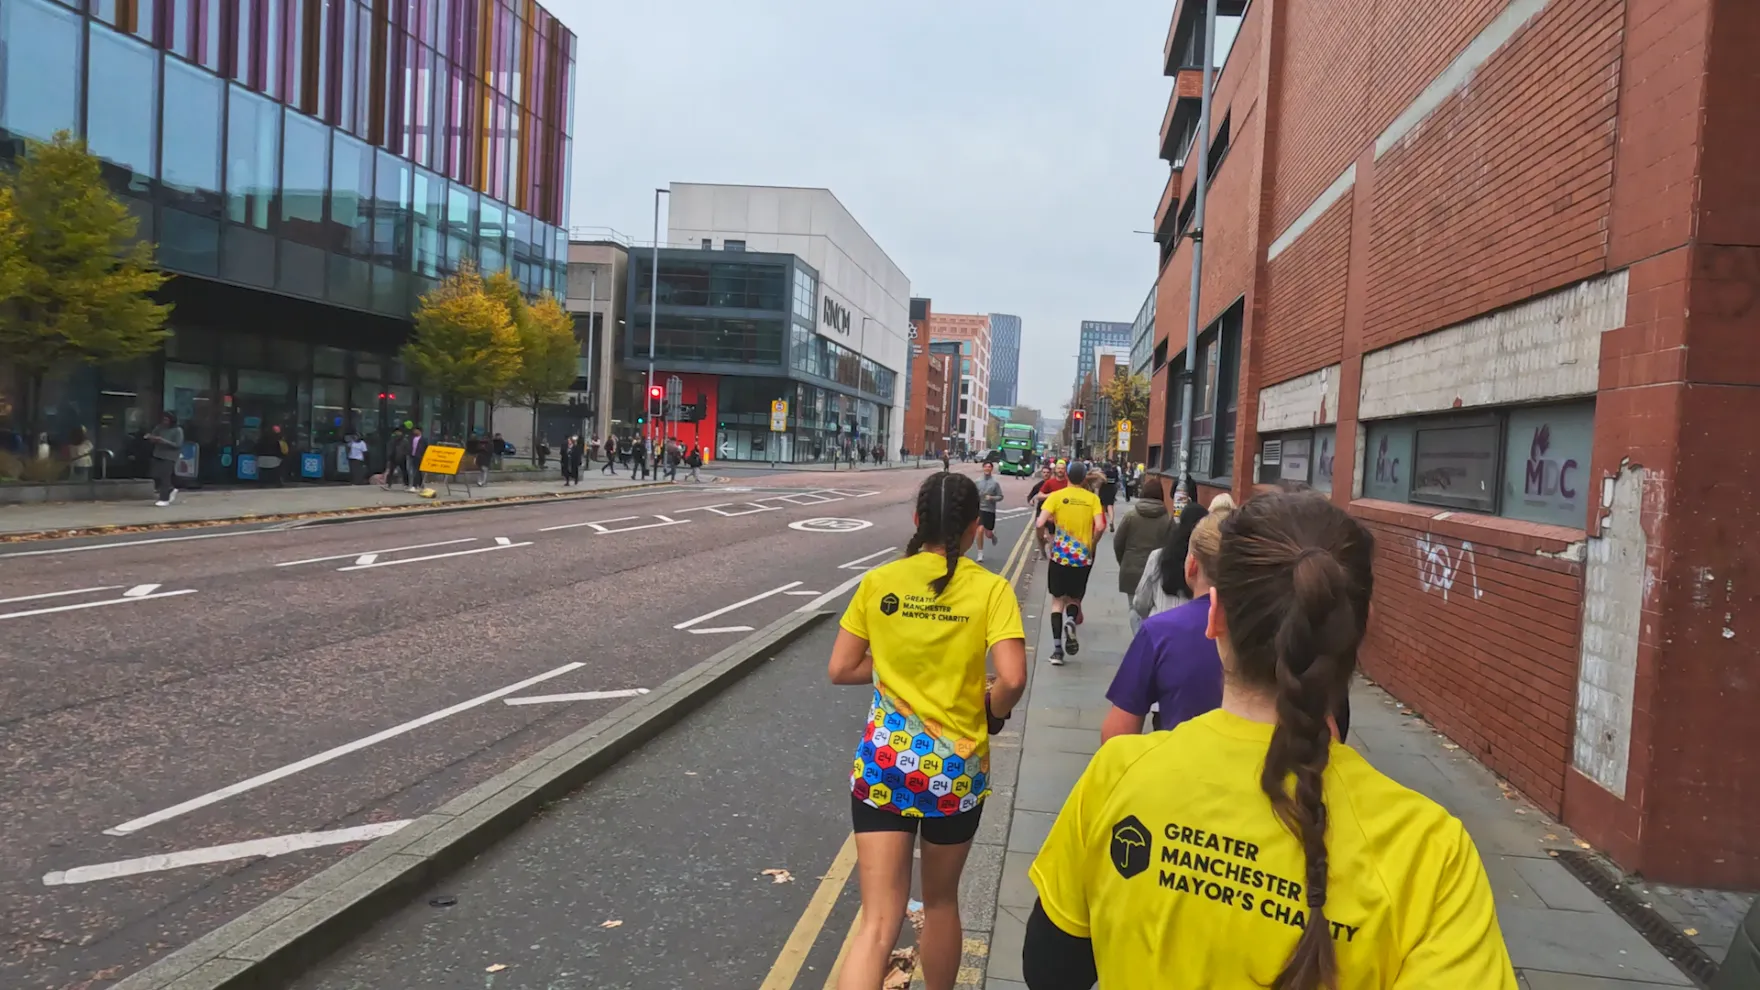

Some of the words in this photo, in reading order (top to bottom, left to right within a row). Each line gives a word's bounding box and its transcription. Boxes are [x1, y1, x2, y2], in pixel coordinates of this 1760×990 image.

[823, 295, 850, 337] RNCM
[1525, 459, 1578, 499] MDC
[902, 602, 952, 613] MANCHESTER
[901, 611, 936, 620] MAYOR'S
[938, 614, 970, 623] CHARITY
[874, 731, 888, 740] 24
[893, 735, 908, 746] 24
[915, 739, 930, 750] 24
[878, 752, 892, 763] 24
[900, 755, 915, 767] 24
[923, 759, 938, 770] 24
[947, 762, 960, 772] 24
[866, 768, 879, 779] 24
[909, 777, 924, 787] 24
[933, 780, 948, 791] 24
[956, 781, 969, 791] 24
[872, 789, 887, 800] 24
[895, 793, 910, 804] 24
[1164, 823, 1259, 861] GREATER
[1161, 846, 1302, 902] MANCHESTER
[1159, 870, 1255, 911] MAYOR'S
[1260, 898, 1360, 942] CHATY
